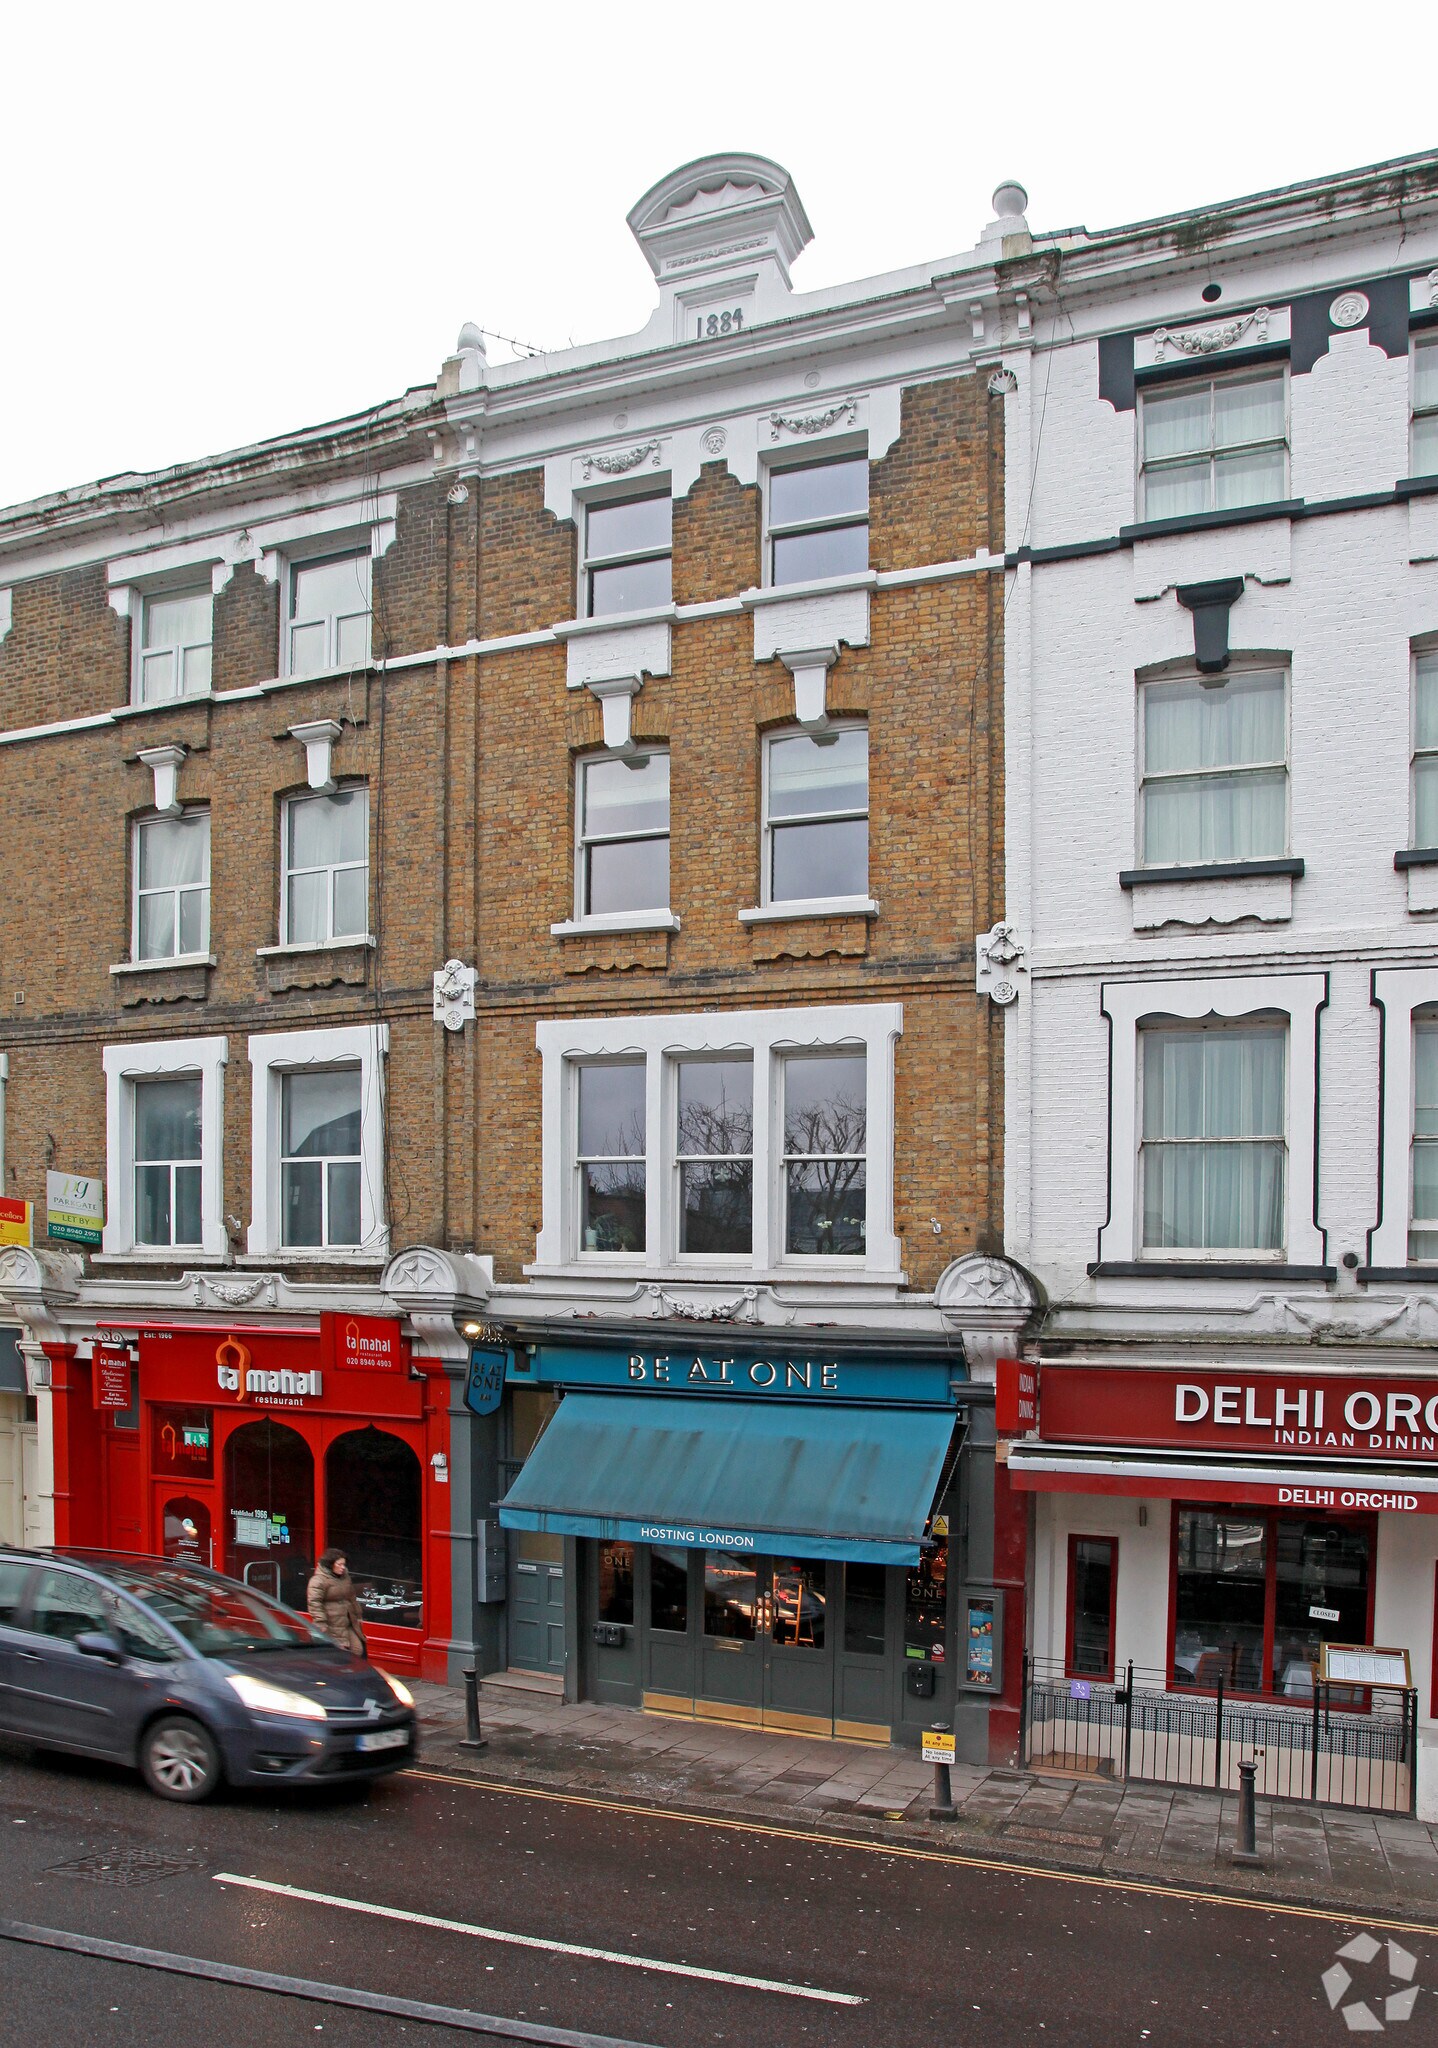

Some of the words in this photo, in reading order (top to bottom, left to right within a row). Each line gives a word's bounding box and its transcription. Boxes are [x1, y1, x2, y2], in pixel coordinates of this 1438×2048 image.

[697, 307, 744, 339] 1884
[53, 1196, 98, 1211] PARKGATE
[61, 1214, 77, 1223] LET
[78, 1217, 91, 1225] BY
[66, 1227, 83, 1235] 8940
[346, 1357, 359, 1365] 020
[360, 1358, 376, 1367] 8940
[376, 1359, 392, 1368] 4903
[474, 1362, 485, 1374] BE
[489, 1365, 502, 1376] AT
[628, 1354, 669, 1382] BE
[687, 1356, 734, 1385] AT
[749, 1359, 838, 1390] ONE
[472, 1375, 501, 1391] ONE
[1019, 1373, 1035, 1394] INDIAN
[255, 1395, 304, 1406] restaurant
[1175, 1384, 1324, 1428] DELHI
[1018, 1399, 1034, 1419] DINING
[1274, 1429, 1355, 1447] INDIAN
[1278, 1488, 1335, 1505] DELHI
[1340, 1491, 1418, 1510] ORCHID
[254, 1509, 268, 1519] 1966
[641, 1527, 695, 1542] HOSTING
[699, 1532, 755, 1547] LONDON
[604, 1556, 631, 1567] ONE
[911, 1587, 942, 1599] ONE
[1312, 1609, 1336, 1618] CLOSED
